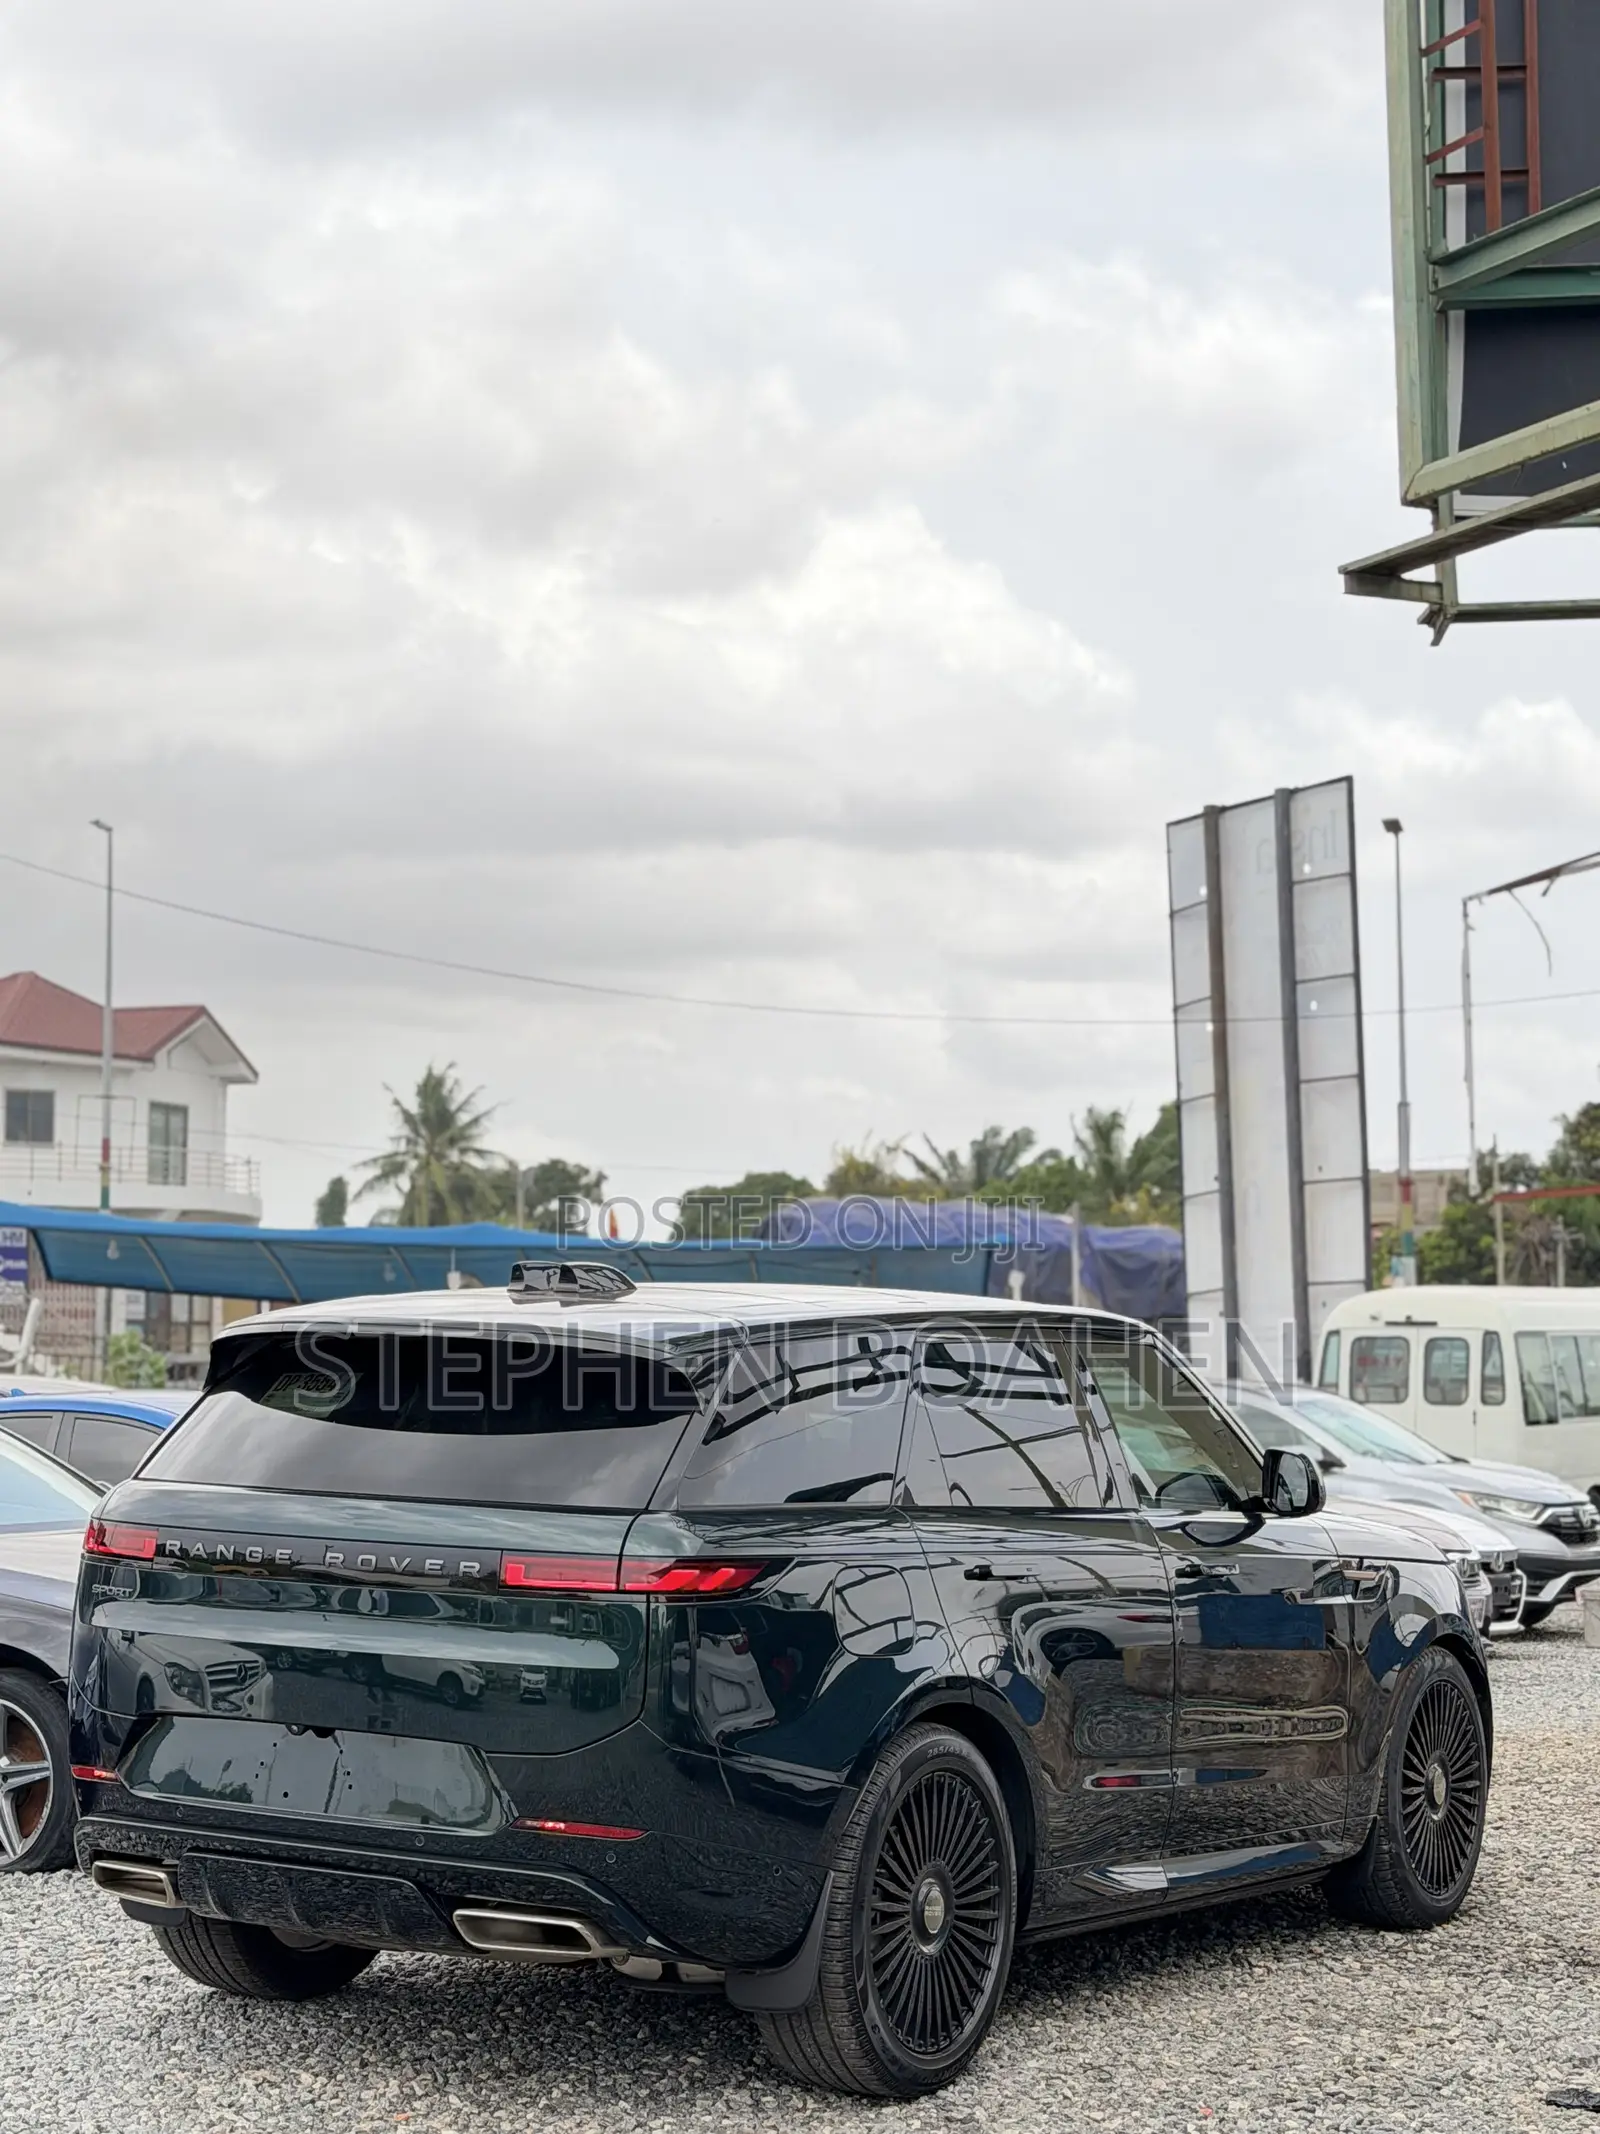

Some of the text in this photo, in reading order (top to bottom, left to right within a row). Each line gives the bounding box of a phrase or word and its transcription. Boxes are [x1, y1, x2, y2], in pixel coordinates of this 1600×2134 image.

[165, 1539, 481, 1578] RANGE ROVER
[92, 1584, 133, 1597] SPORT
